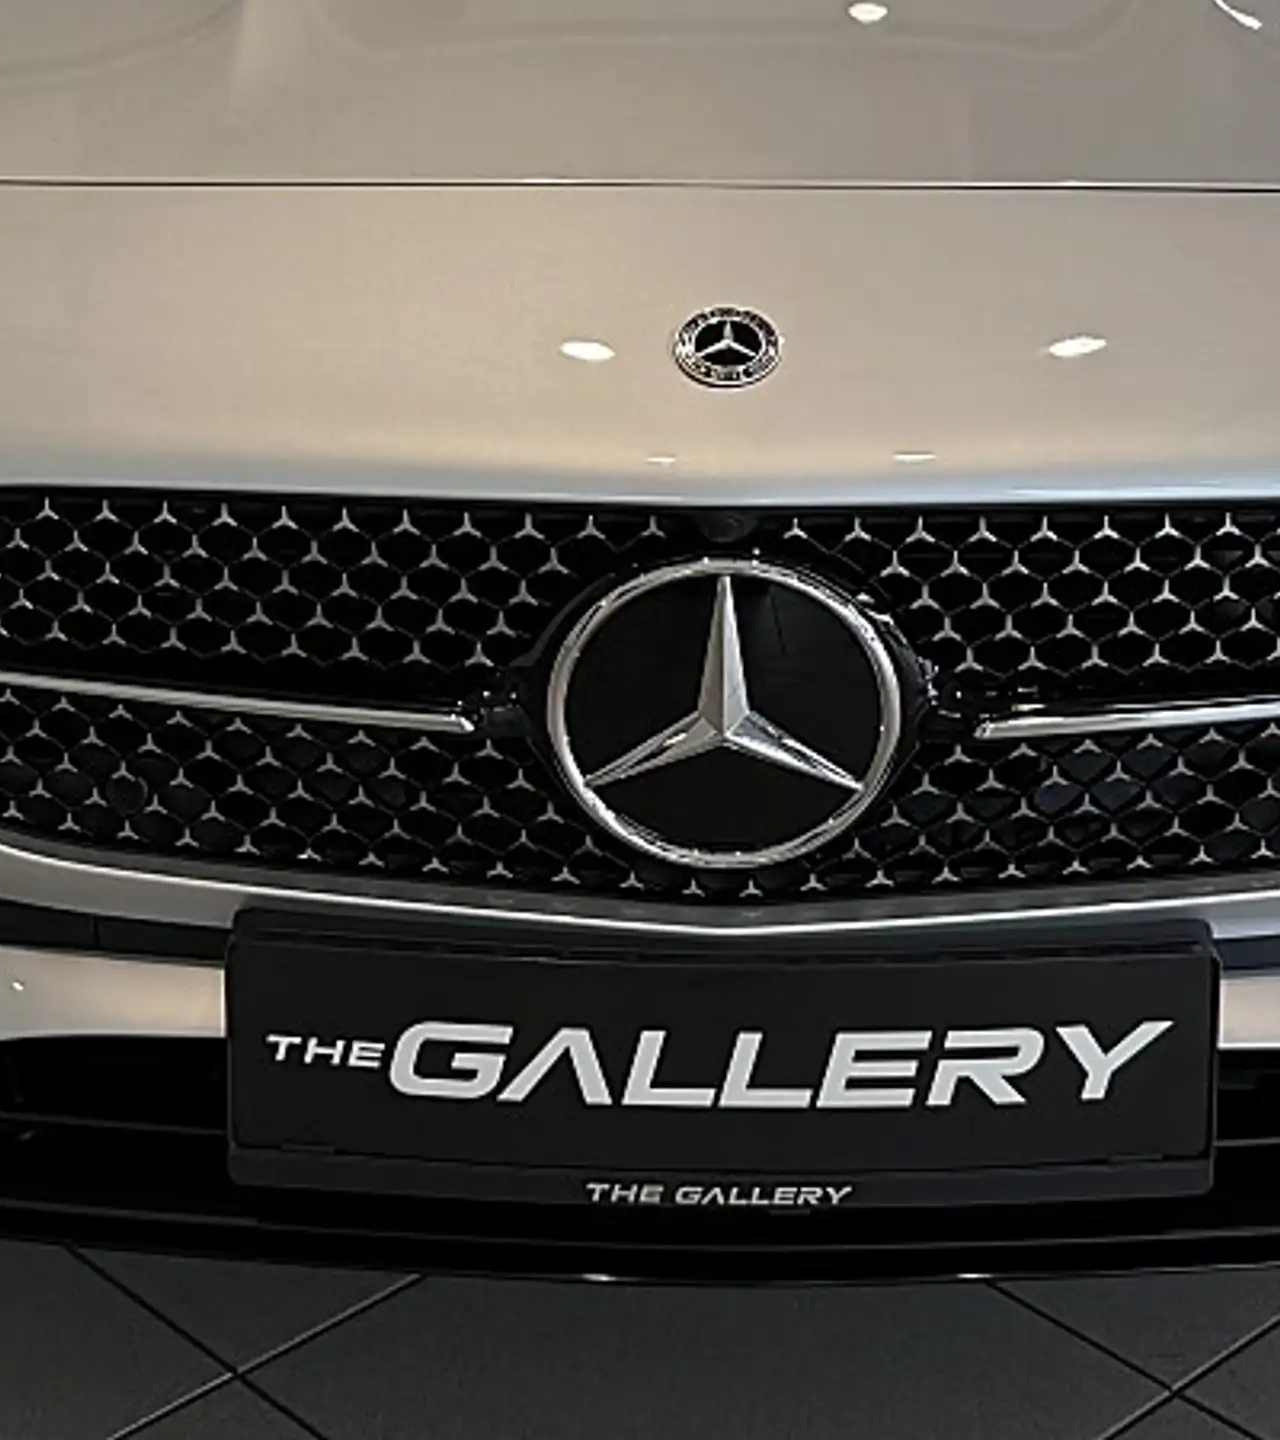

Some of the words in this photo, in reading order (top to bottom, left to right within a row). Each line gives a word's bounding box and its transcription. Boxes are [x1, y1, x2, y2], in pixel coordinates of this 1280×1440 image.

[266, 1034, 385, 1068] THE
[388, 1020, 1174, 1109] GALLERY
[586, 1182, 664, 1204] THE
[674, 1185, 853, 1206] GALLERY
